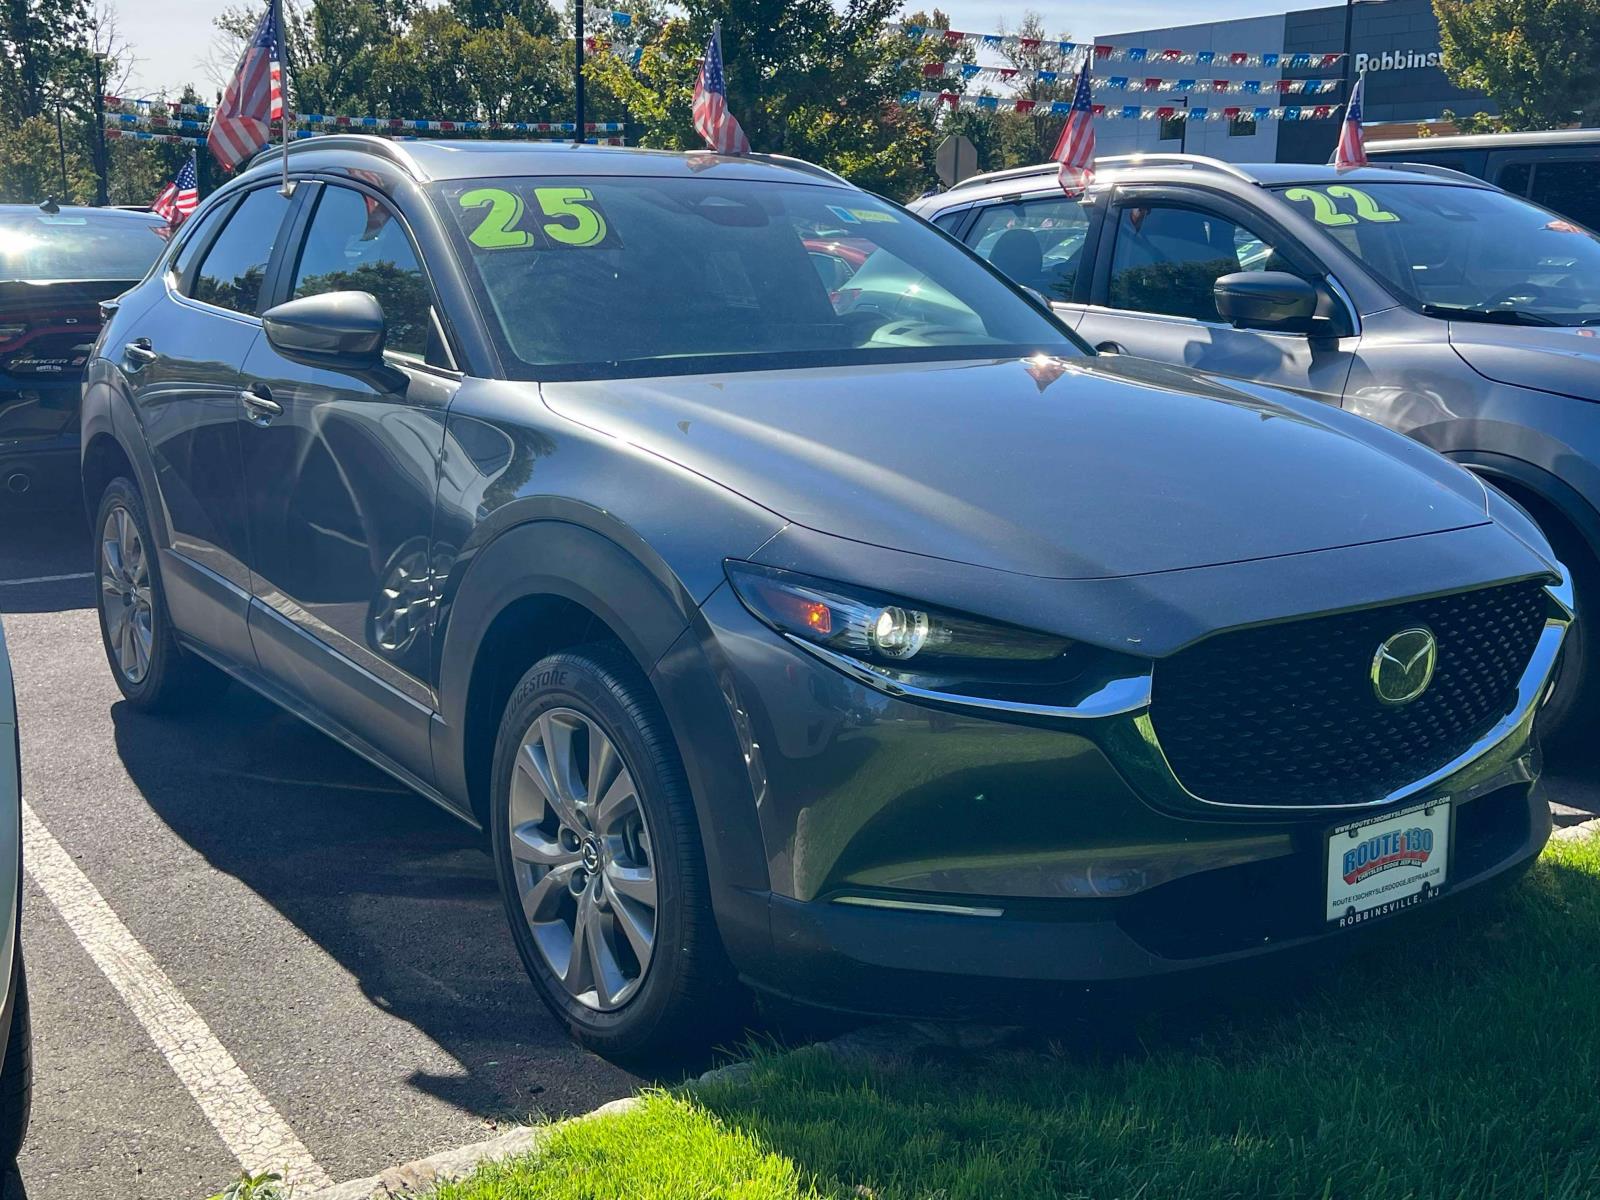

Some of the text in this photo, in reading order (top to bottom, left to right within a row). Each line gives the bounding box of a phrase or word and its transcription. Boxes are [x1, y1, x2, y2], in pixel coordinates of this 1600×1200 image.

[459, 186, 607, 250] 25
[1285, 186, 1400, 226] 22
[1343, 827, 1434, 877] ROUTE 130
[1340, 887, 1439, 927] ROBBINSVILLE, NJ
